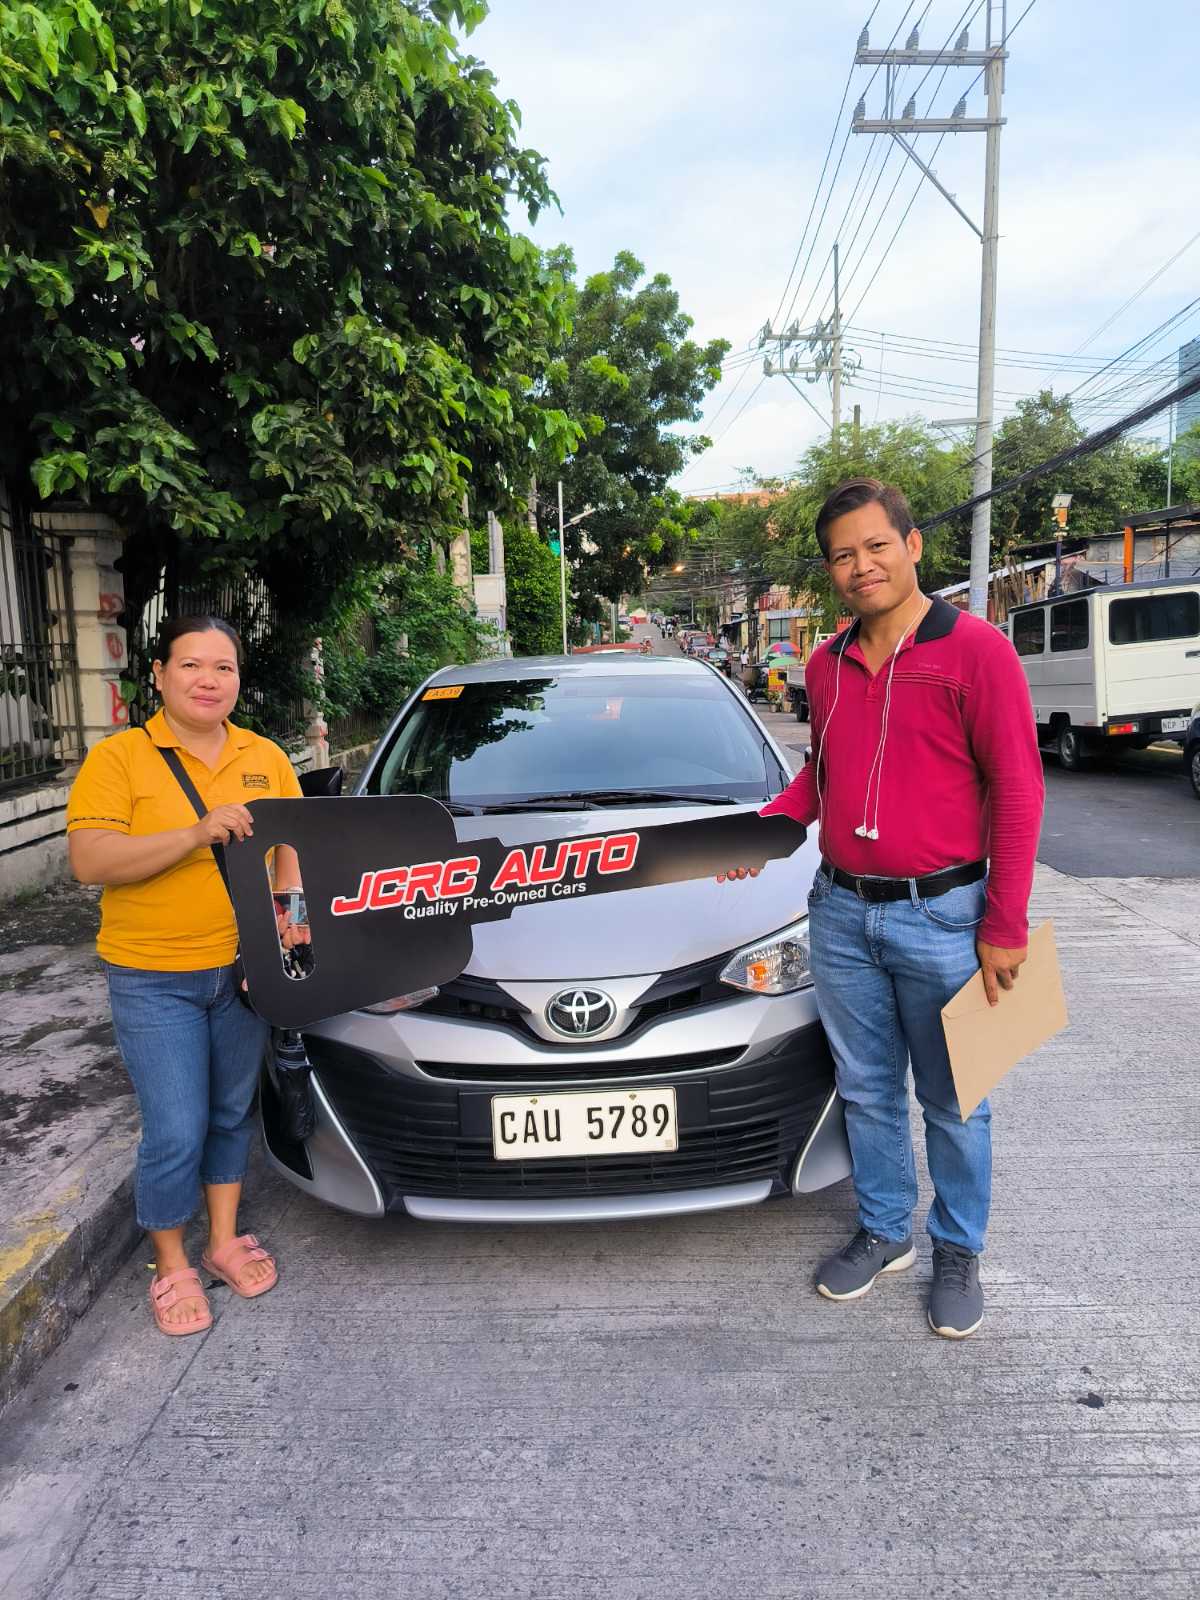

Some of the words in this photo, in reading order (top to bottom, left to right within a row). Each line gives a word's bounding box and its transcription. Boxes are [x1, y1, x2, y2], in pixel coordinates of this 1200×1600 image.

[331, 856, 480, 916] JCRC
[491, 832, 640, 891] AUTO
[403, 897, 458, 920] Quality
[463, 886, 547, 912] Pre-Owned
[552, 881, 587, 897] Cars
[500, 1109, 561, 1144] CAU
[587, 1103, 669, 1140] 5789
